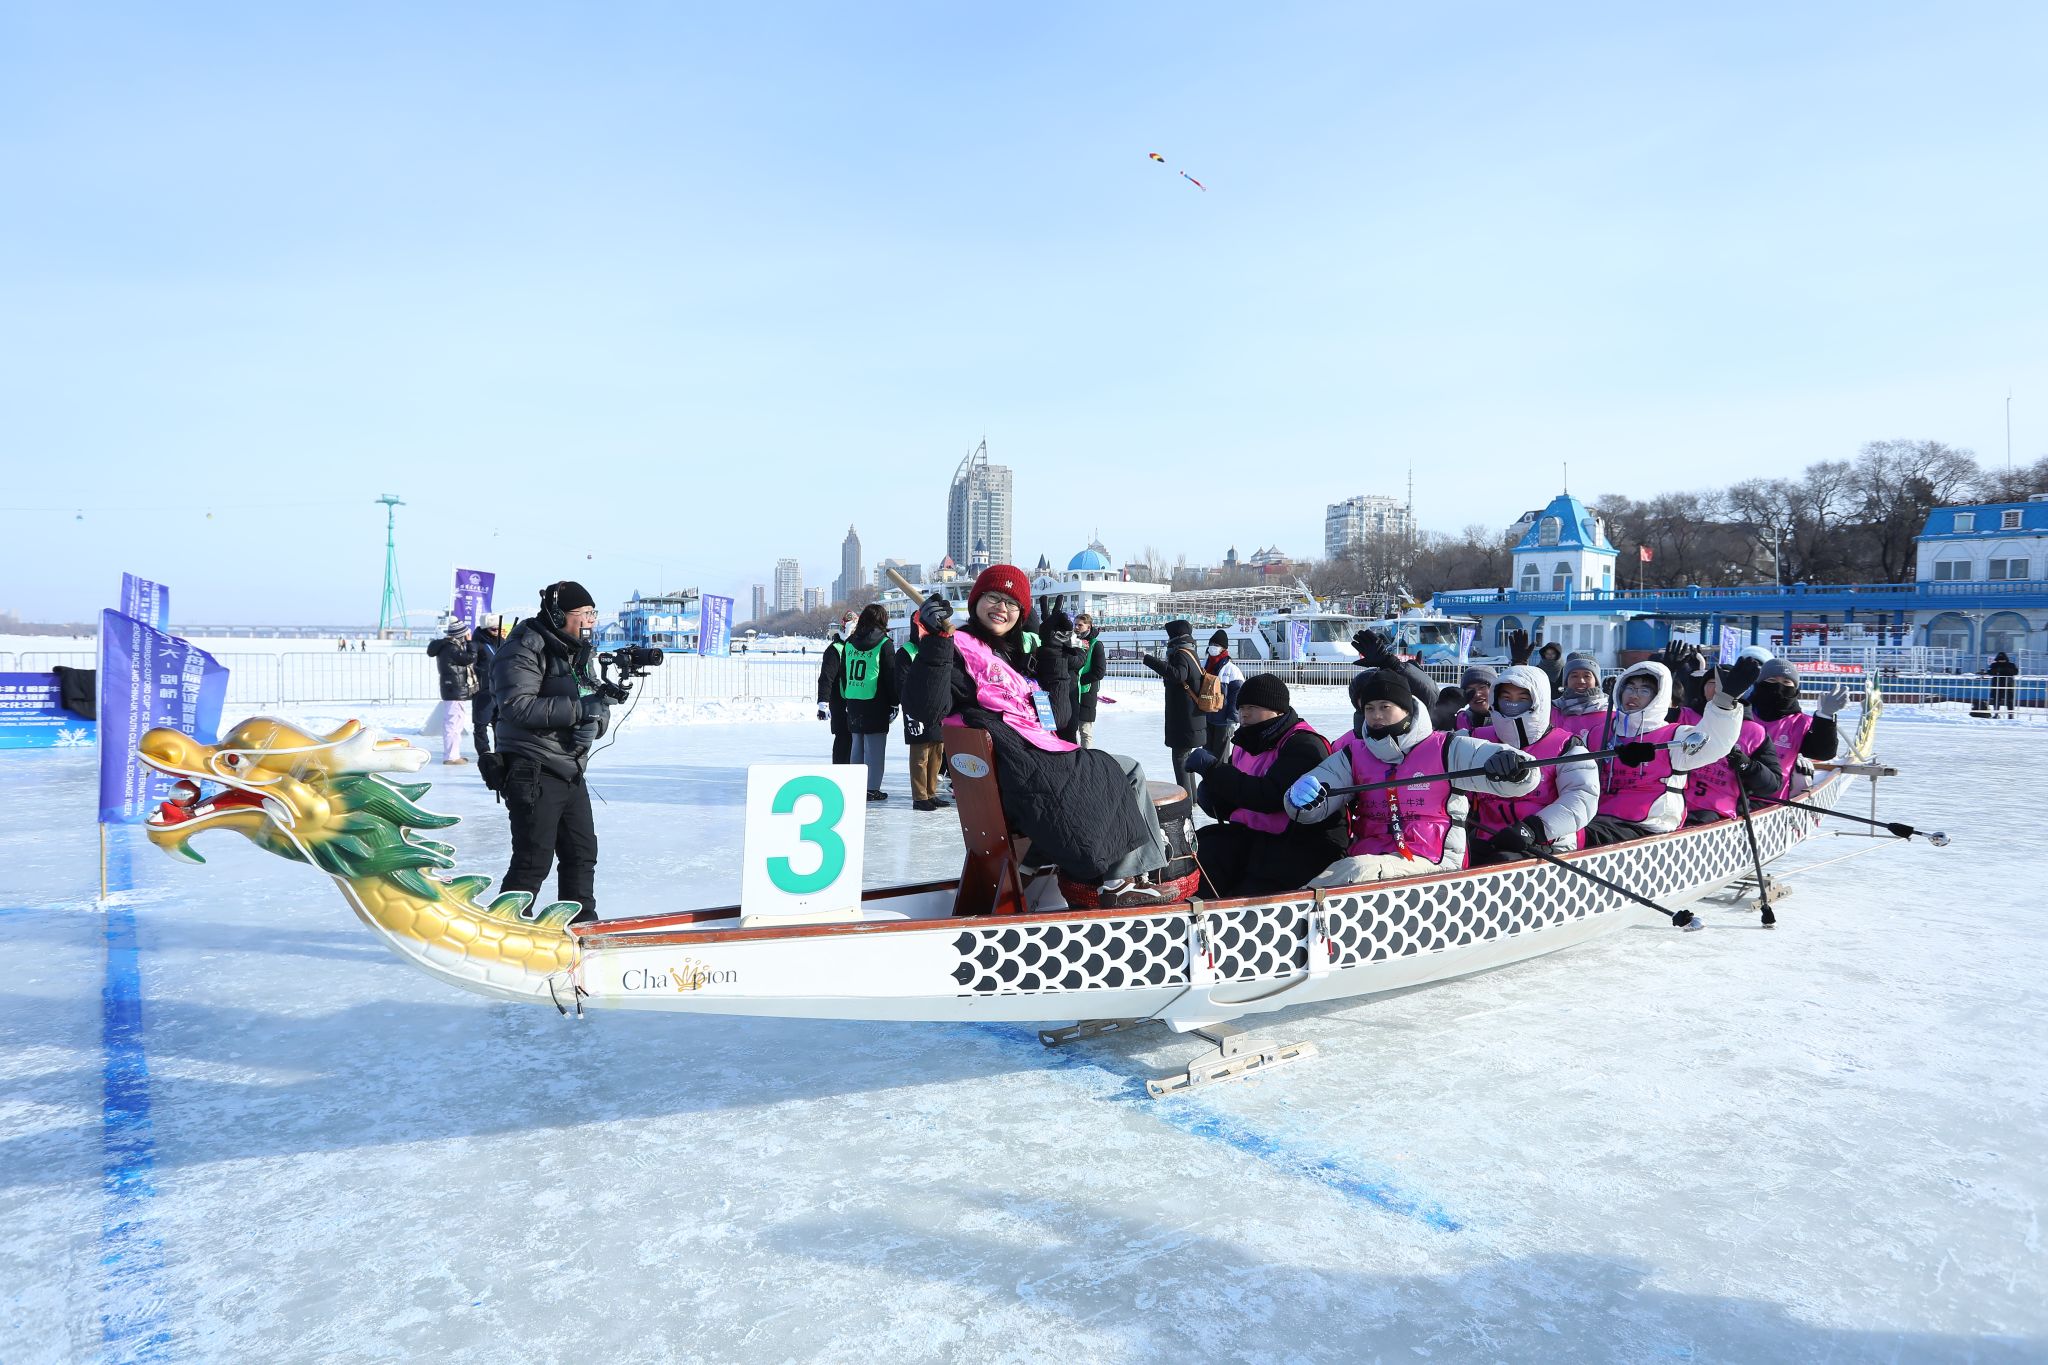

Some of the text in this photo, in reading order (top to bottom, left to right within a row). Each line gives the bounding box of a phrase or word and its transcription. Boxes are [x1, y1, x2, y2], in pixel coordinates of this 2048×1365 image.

[131, 652, 140, 669] RACE
[143, 629, 154, 694] CAMBRIDGE-OXFORD
[849, 658, 867, 681] 10
[131, 669, 140, 682] AND
[130, 682, 140, 712] CHINA-UK
[129, 712, 139, 732] YOUTH
[127, 732, 137, 765] CULTURAL
[125, 765, 135, 798] EXCHANGE
[1694, 781, 1708, 797] 5
[123, 798, 133, 816] WEEK
[766, 775, 846, 894] 3
